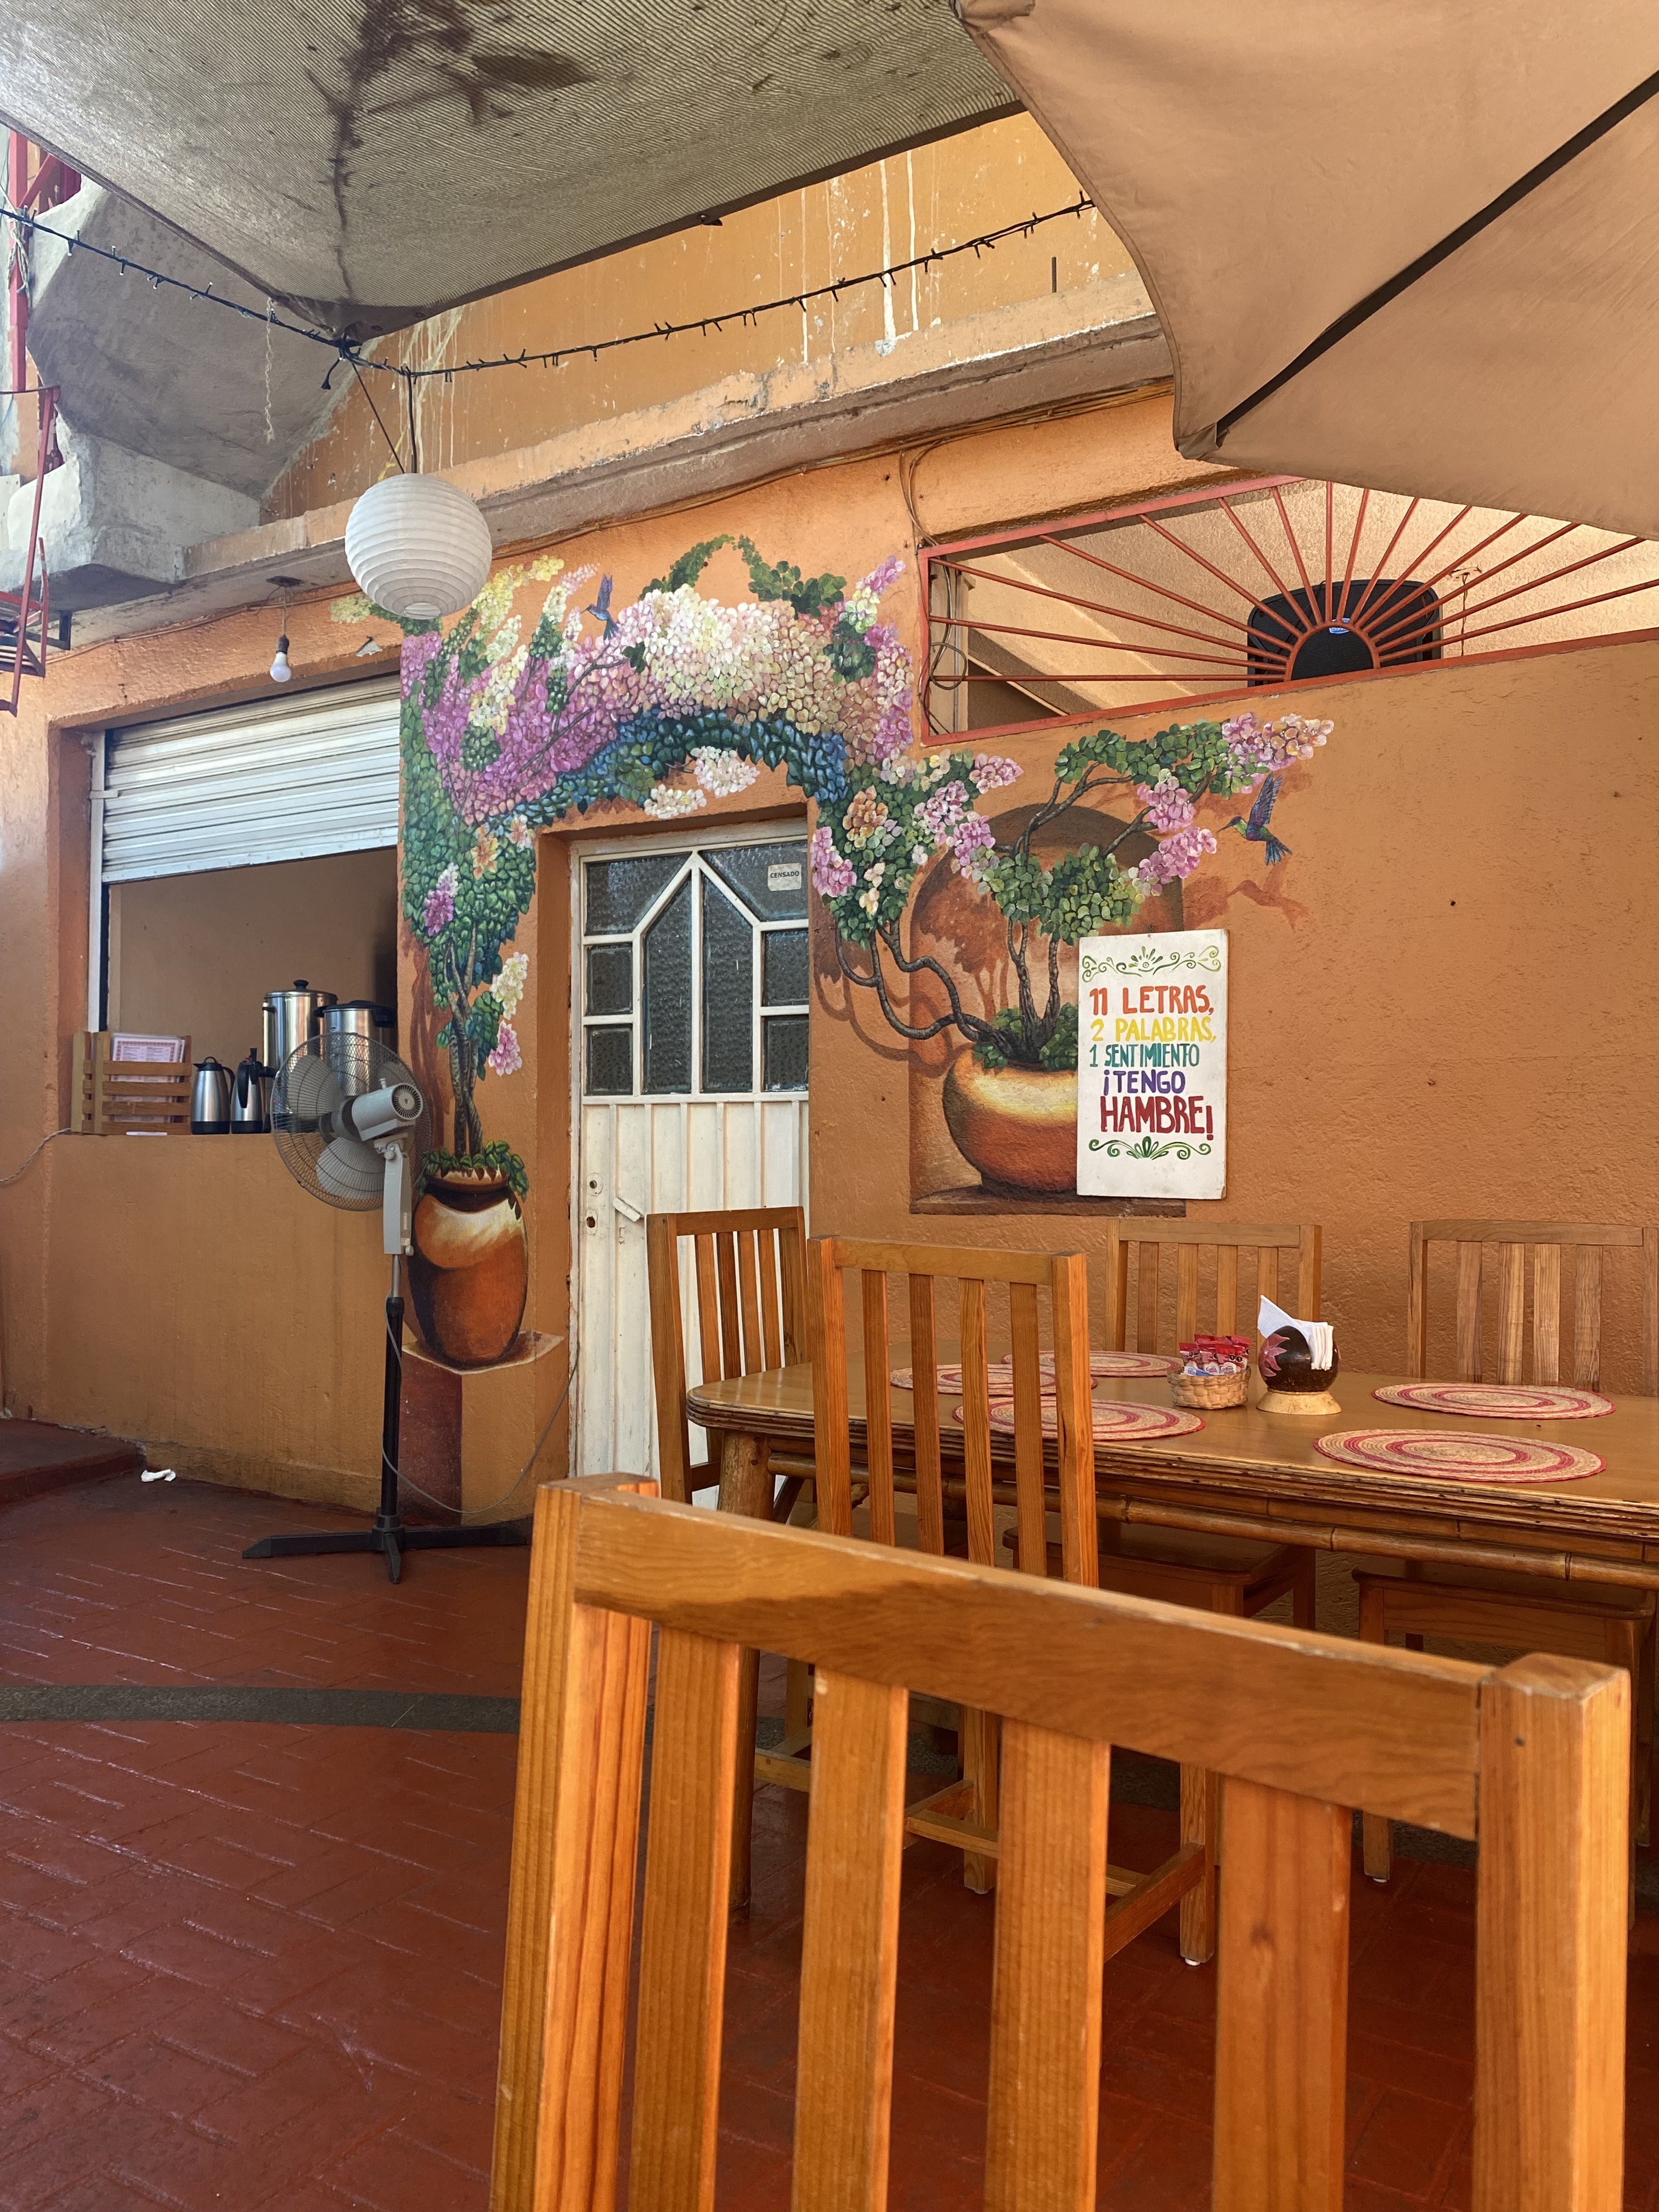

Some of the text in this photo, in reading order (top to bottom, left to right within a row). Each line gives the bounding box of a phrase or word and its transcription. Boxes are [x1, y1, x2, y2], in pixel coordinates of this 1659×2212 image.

[1089, 985, 1214, 1015] 11 LETRAS,
[1090, 1017, 1216, 1042] 2 PALABRAS,
[1090, 1043, 1200, 1068] 1 SENTIMIENTO
[1103, 1069, 1186, 1096] ¡TENGO
[1100, 1096, 1213, 1141] HAMBRE!
